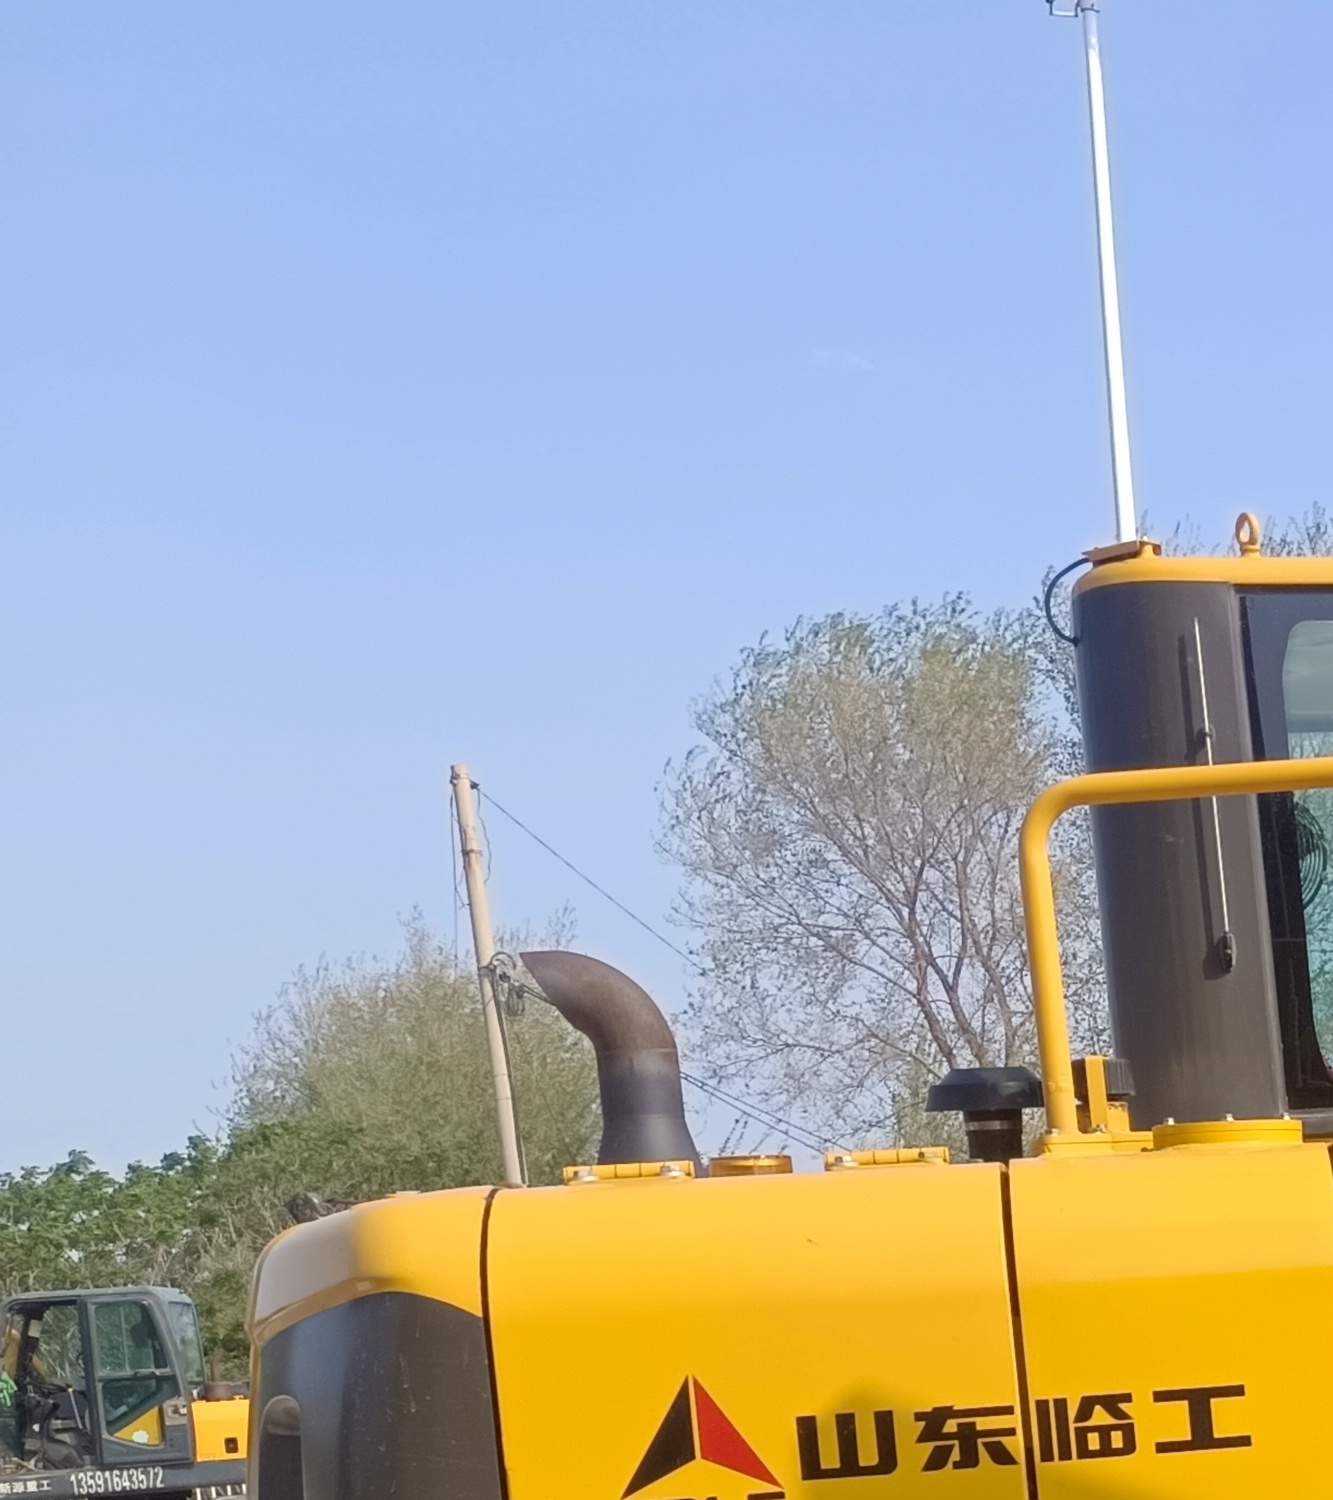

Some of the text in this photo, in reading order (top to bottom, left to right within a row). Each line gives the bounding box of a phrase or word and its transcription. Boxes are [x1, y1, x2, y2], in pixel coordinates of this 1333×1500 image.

[795, 1383, 1253, 1482] 山东临工
[70, 1466, 165, 1496] 13591643572
